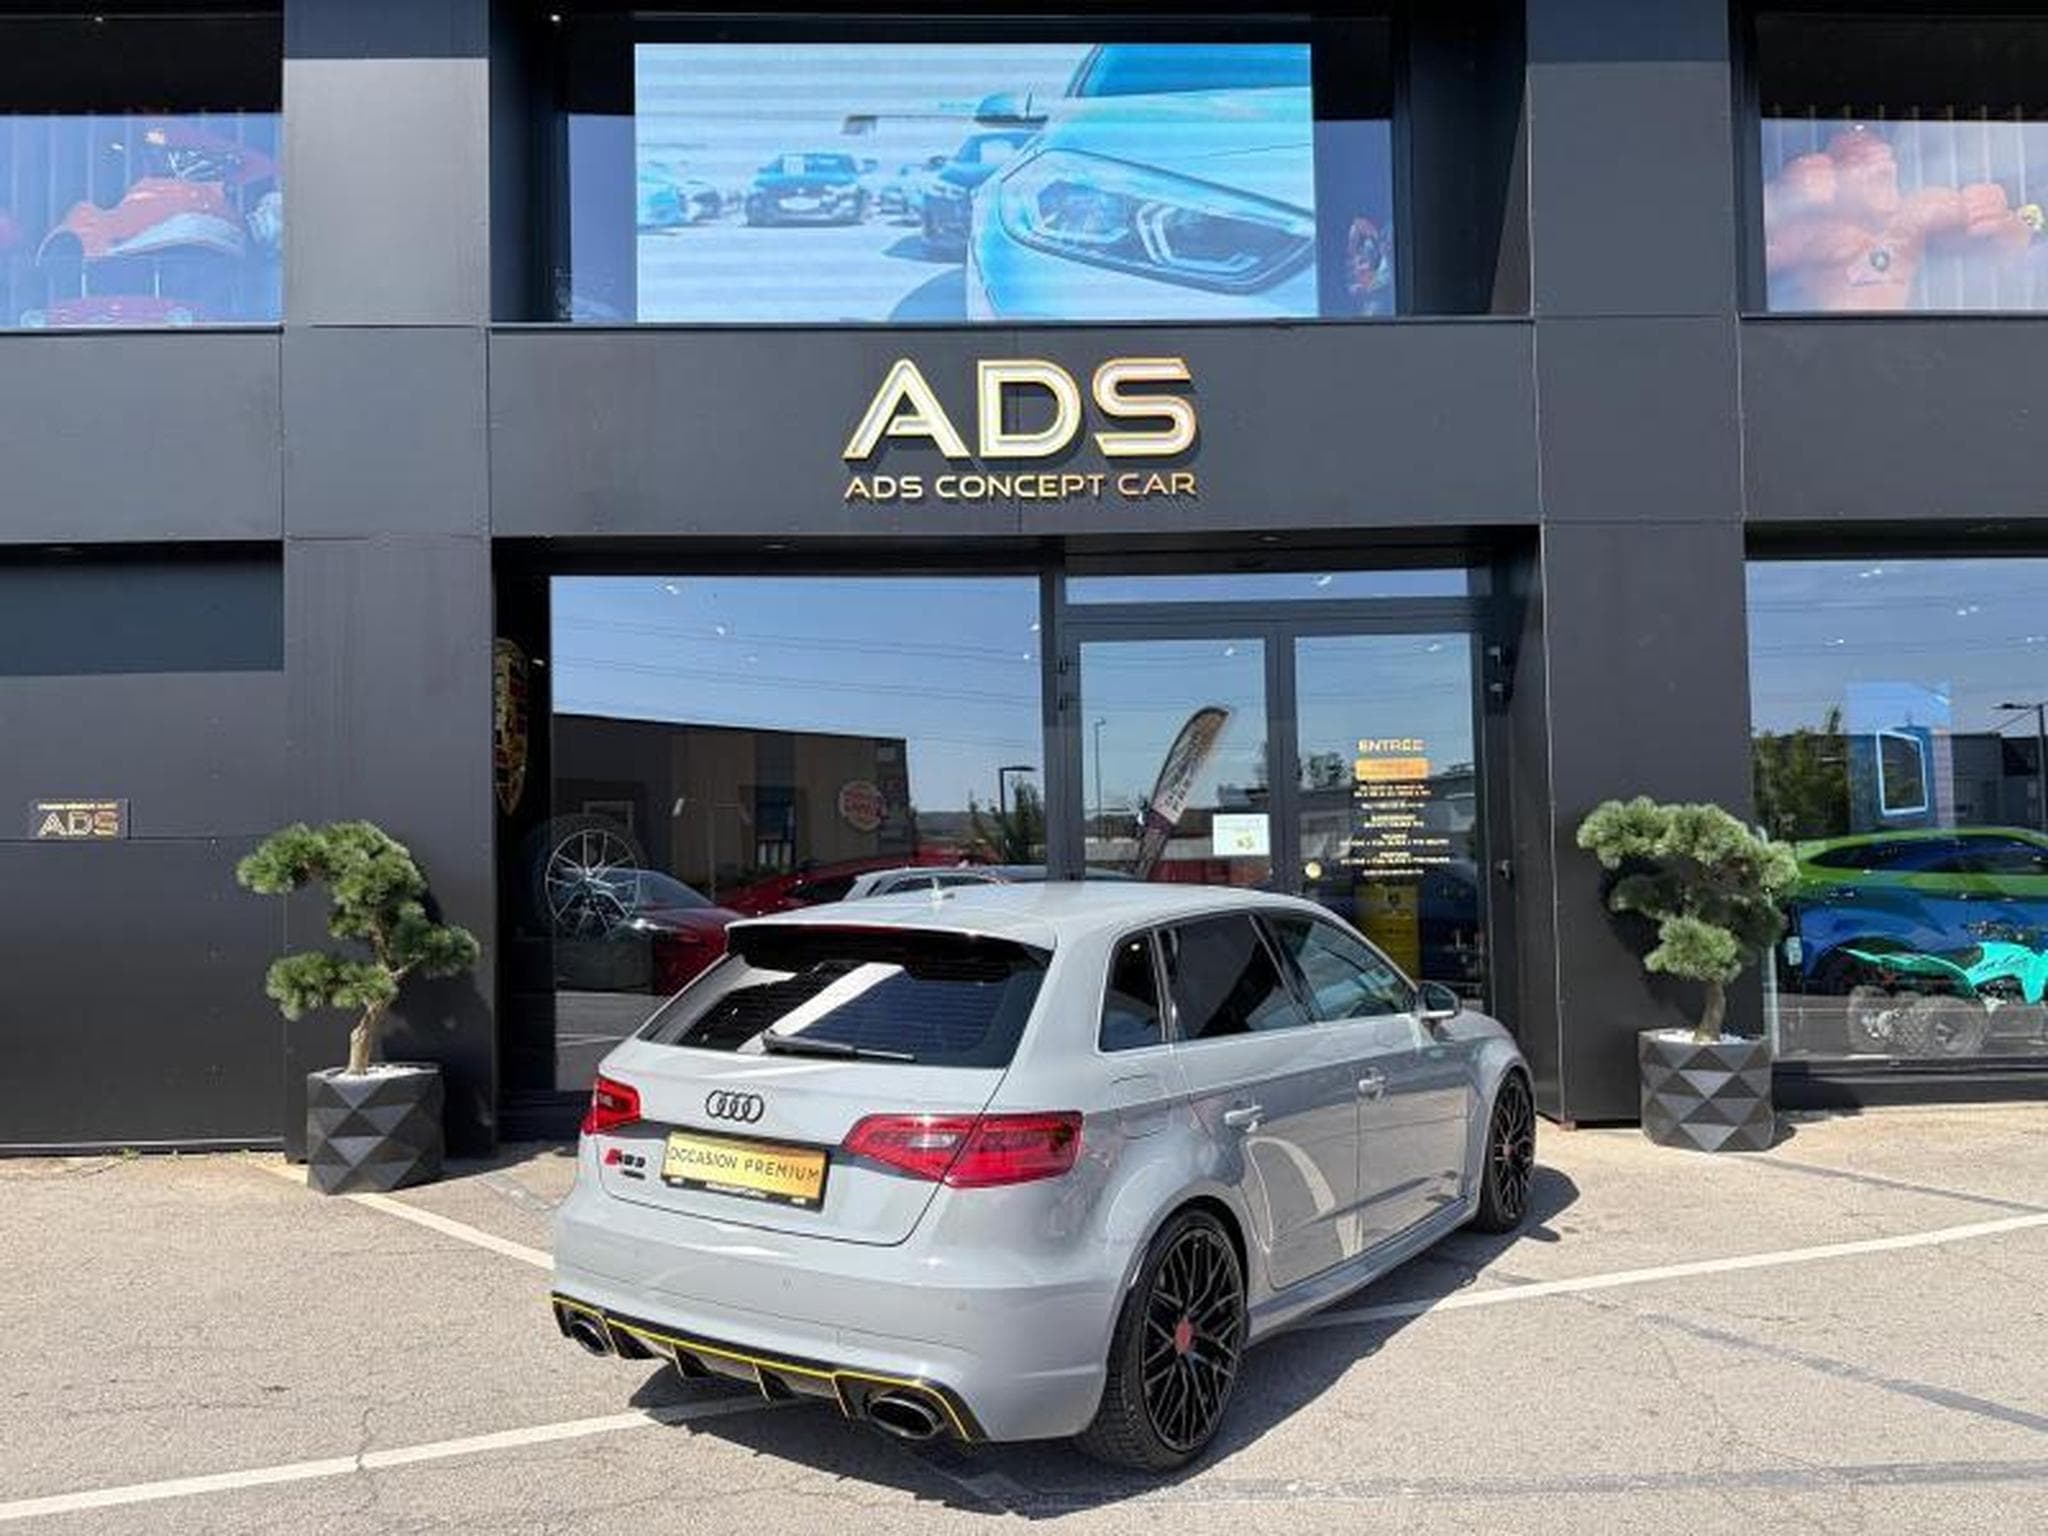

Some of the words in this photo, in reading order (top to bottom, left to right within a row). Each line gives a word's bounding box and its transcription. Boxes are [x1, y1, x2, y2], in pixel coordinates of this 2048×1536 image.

[842, 357, 1197, 459] ADS
[844, 475, 923, 498] ADS
[935, 473, 1105, 498] CONCEPT
[1117, 472, 1197, 496] CAR
[39, 811, 118, 836] ADS
[670, 1146, 738, 1170] OCCASION
[744, 1159, 819, 1182] PREMIUM
